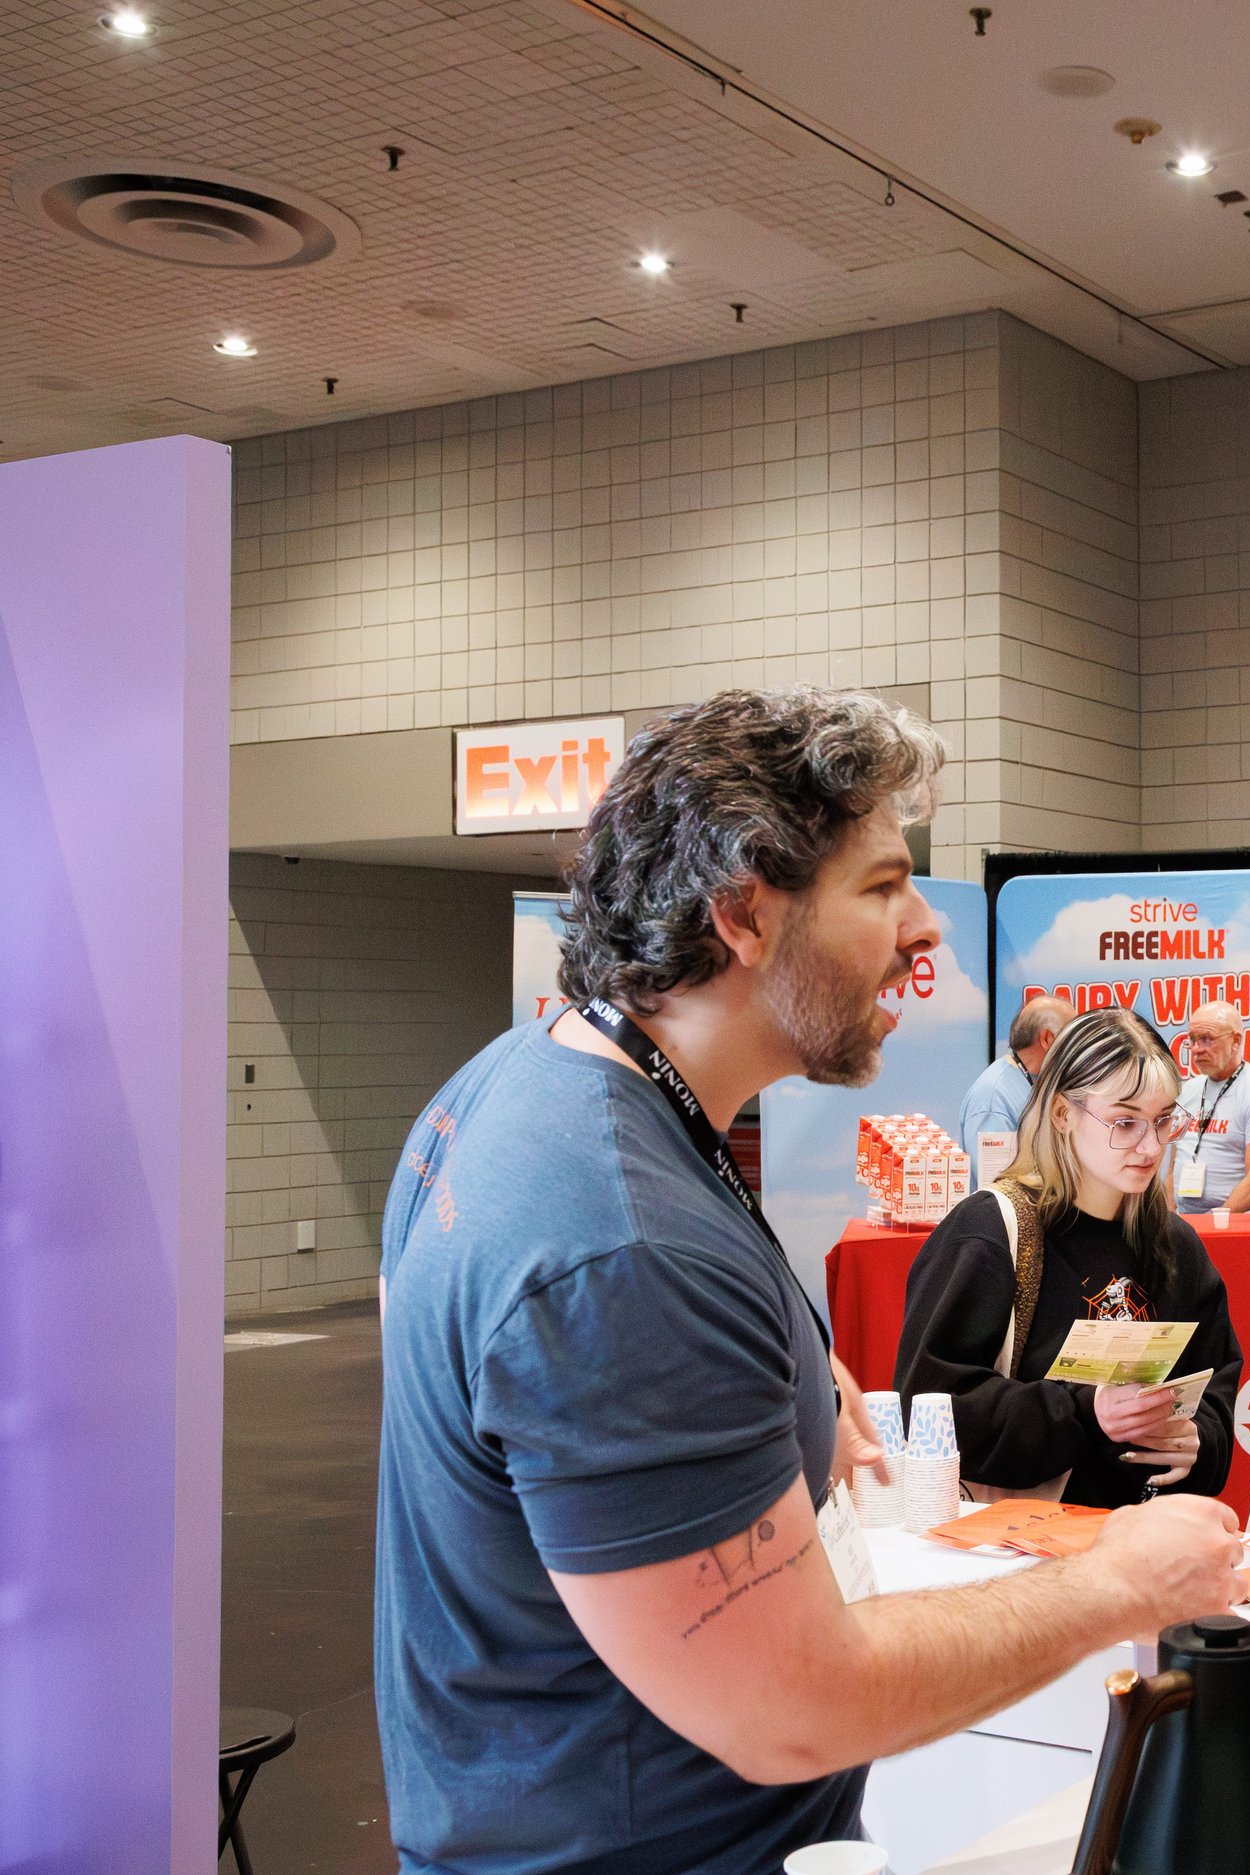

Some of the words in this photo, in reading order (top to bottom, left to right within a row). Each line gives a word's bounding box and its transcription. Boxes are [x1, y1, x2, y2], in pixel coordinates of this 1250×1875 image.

[465, 737, 612, 819] Exit
[1130, 897, 1199, 924] strive
[1099, 928, 1226, 961] FREEMILK
[648, 1049, 701, 1117] MONIN
[713, 1149, 753, 1211] MONIN
